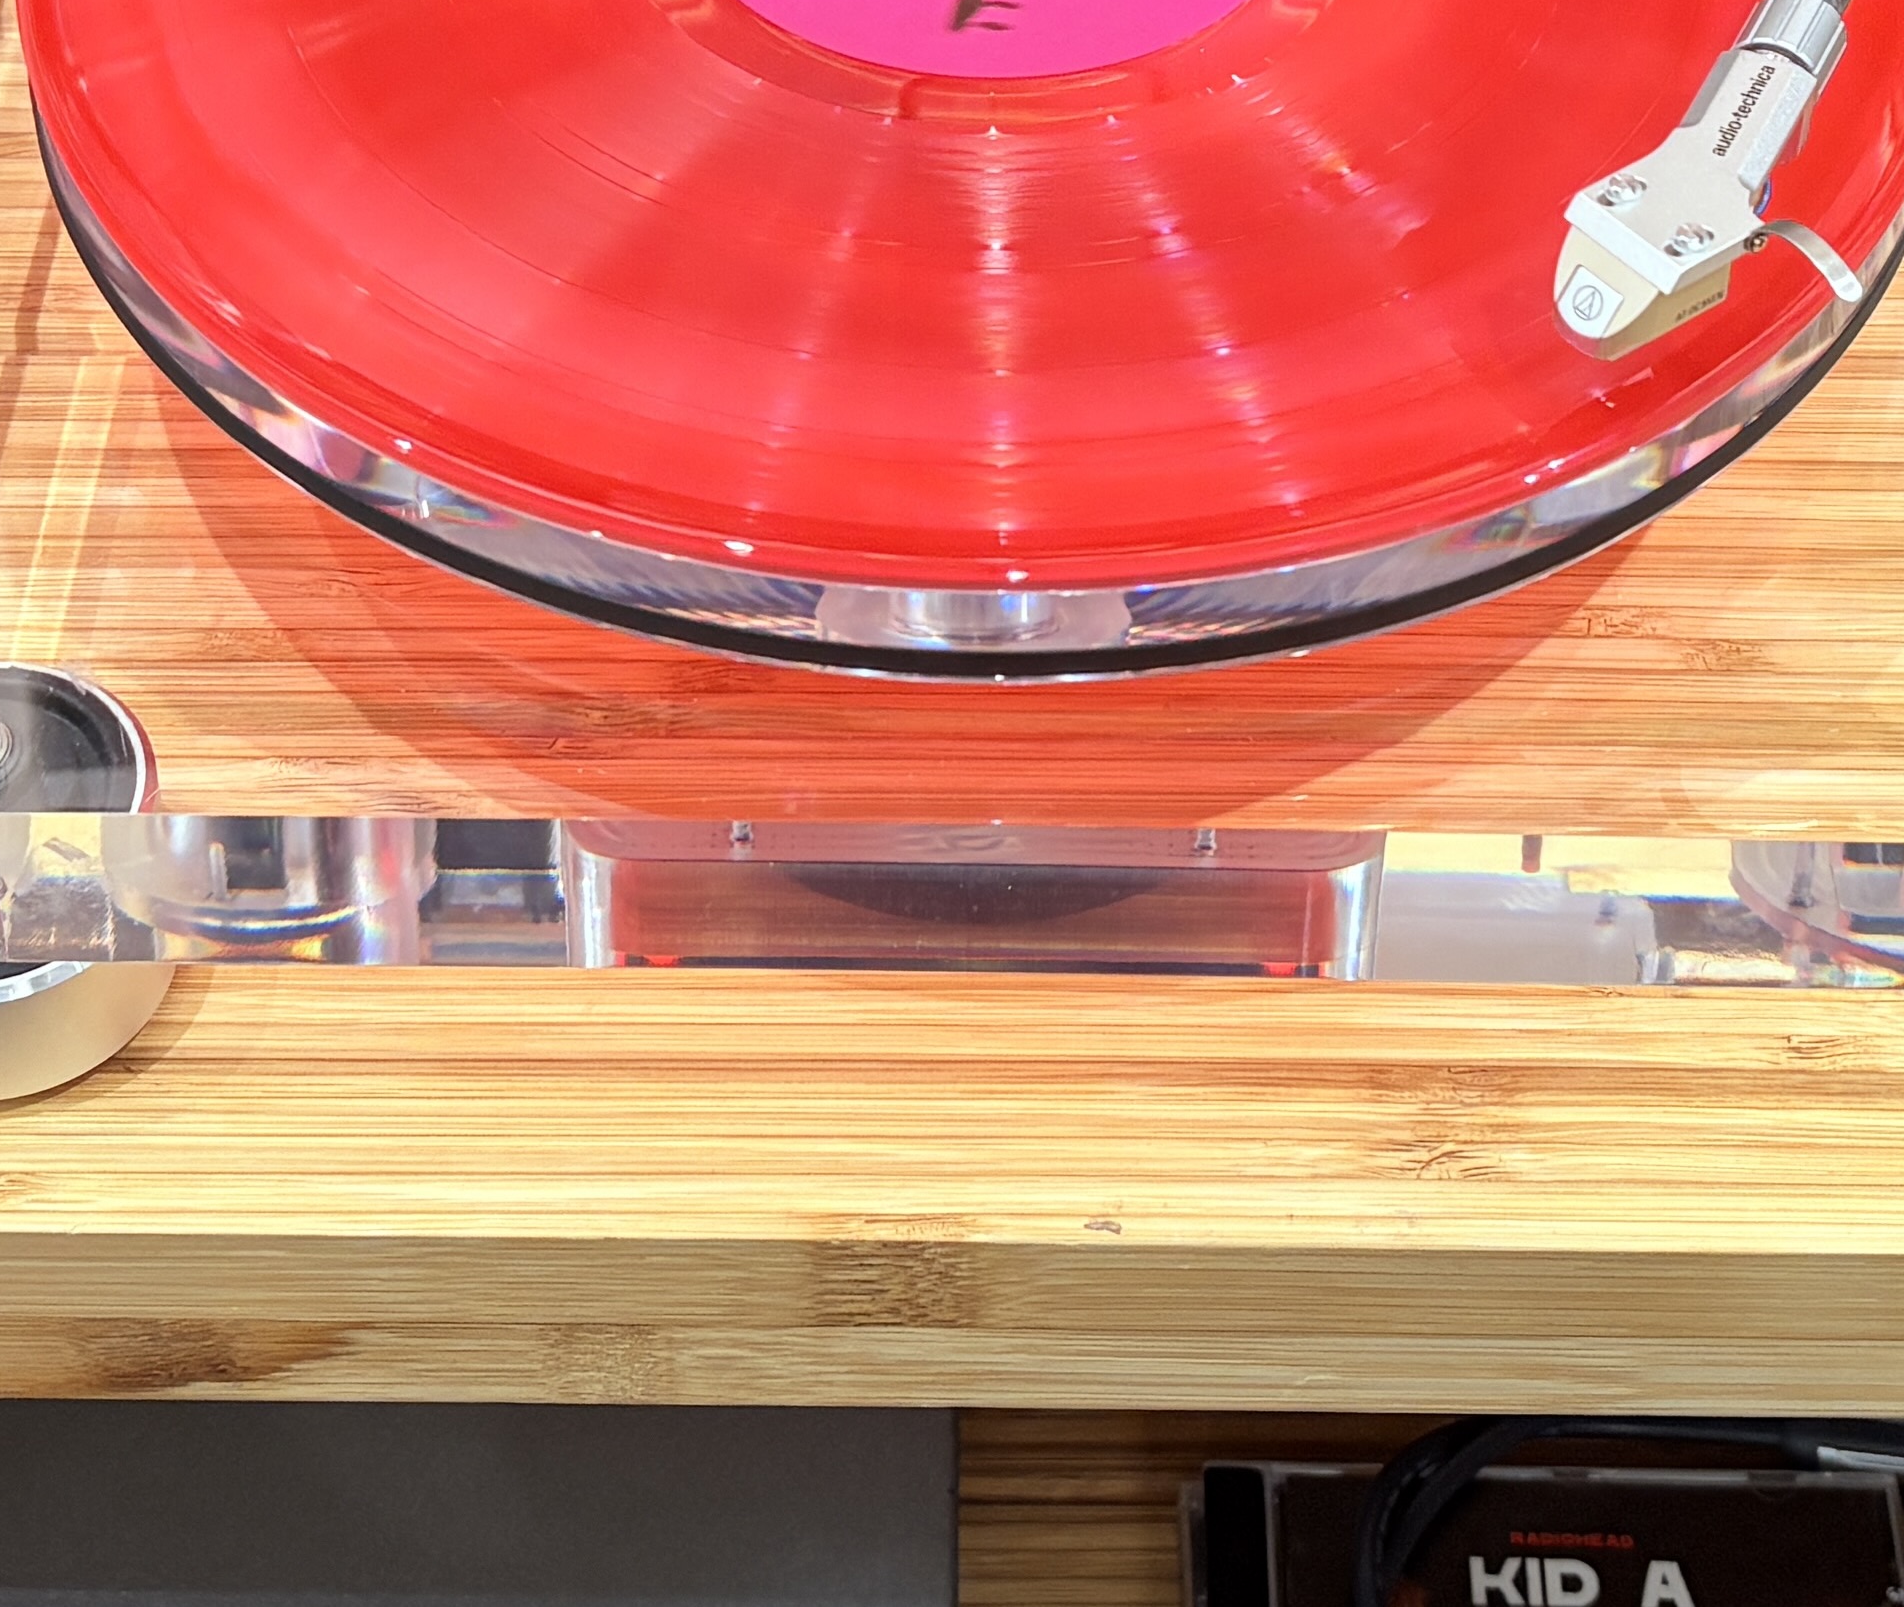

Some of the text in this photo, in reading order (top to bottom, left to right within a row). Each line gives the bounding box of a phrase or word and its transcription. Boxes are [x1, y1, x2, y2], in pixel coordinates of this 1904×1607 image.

[1712, 65, 1776, 158] audio-technica
[1469, 1555, 1697, 1607] KID A
